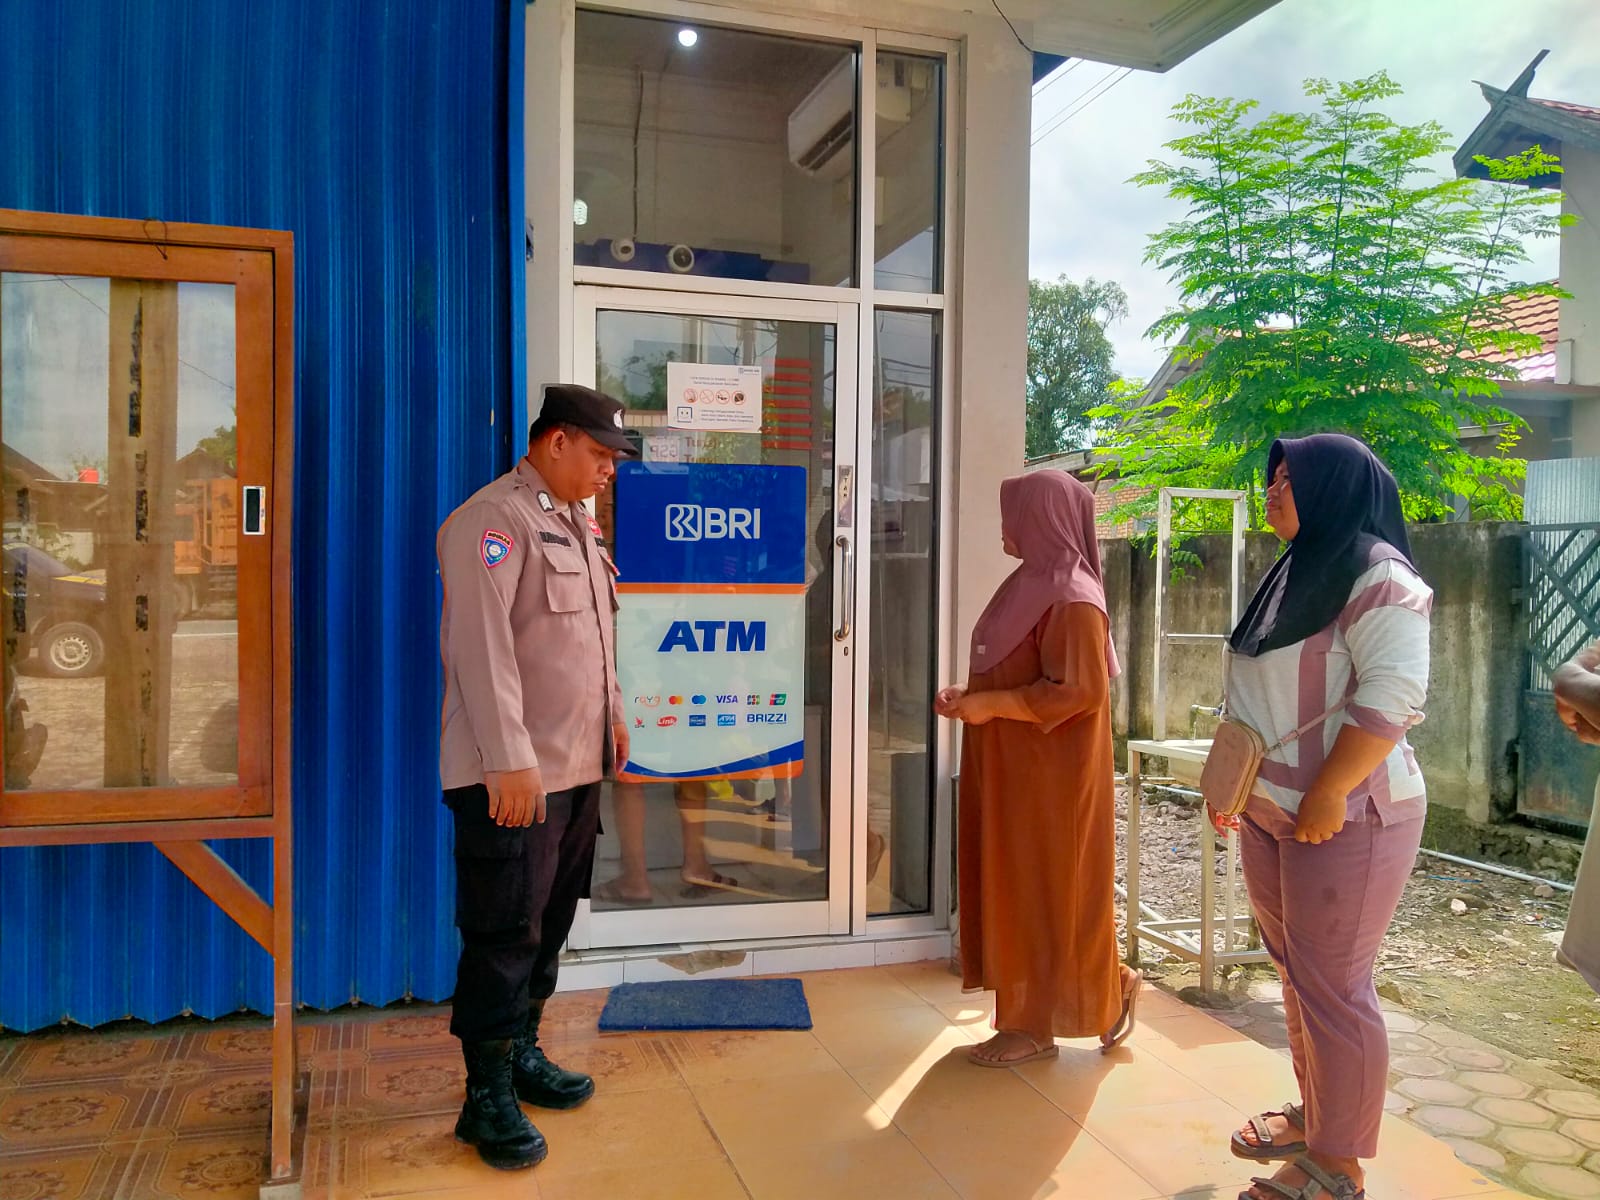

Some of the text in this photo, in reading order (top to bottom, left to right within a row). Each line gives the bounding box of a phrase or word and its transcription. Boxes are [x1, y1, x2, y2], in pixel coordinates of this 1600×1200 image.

[704, 507, 761, 540] BRI
[657, 620, 767, 653] ATM
[716, 695, 738, 704] VISA
[747, 713, 787, 723] BRIZZI
